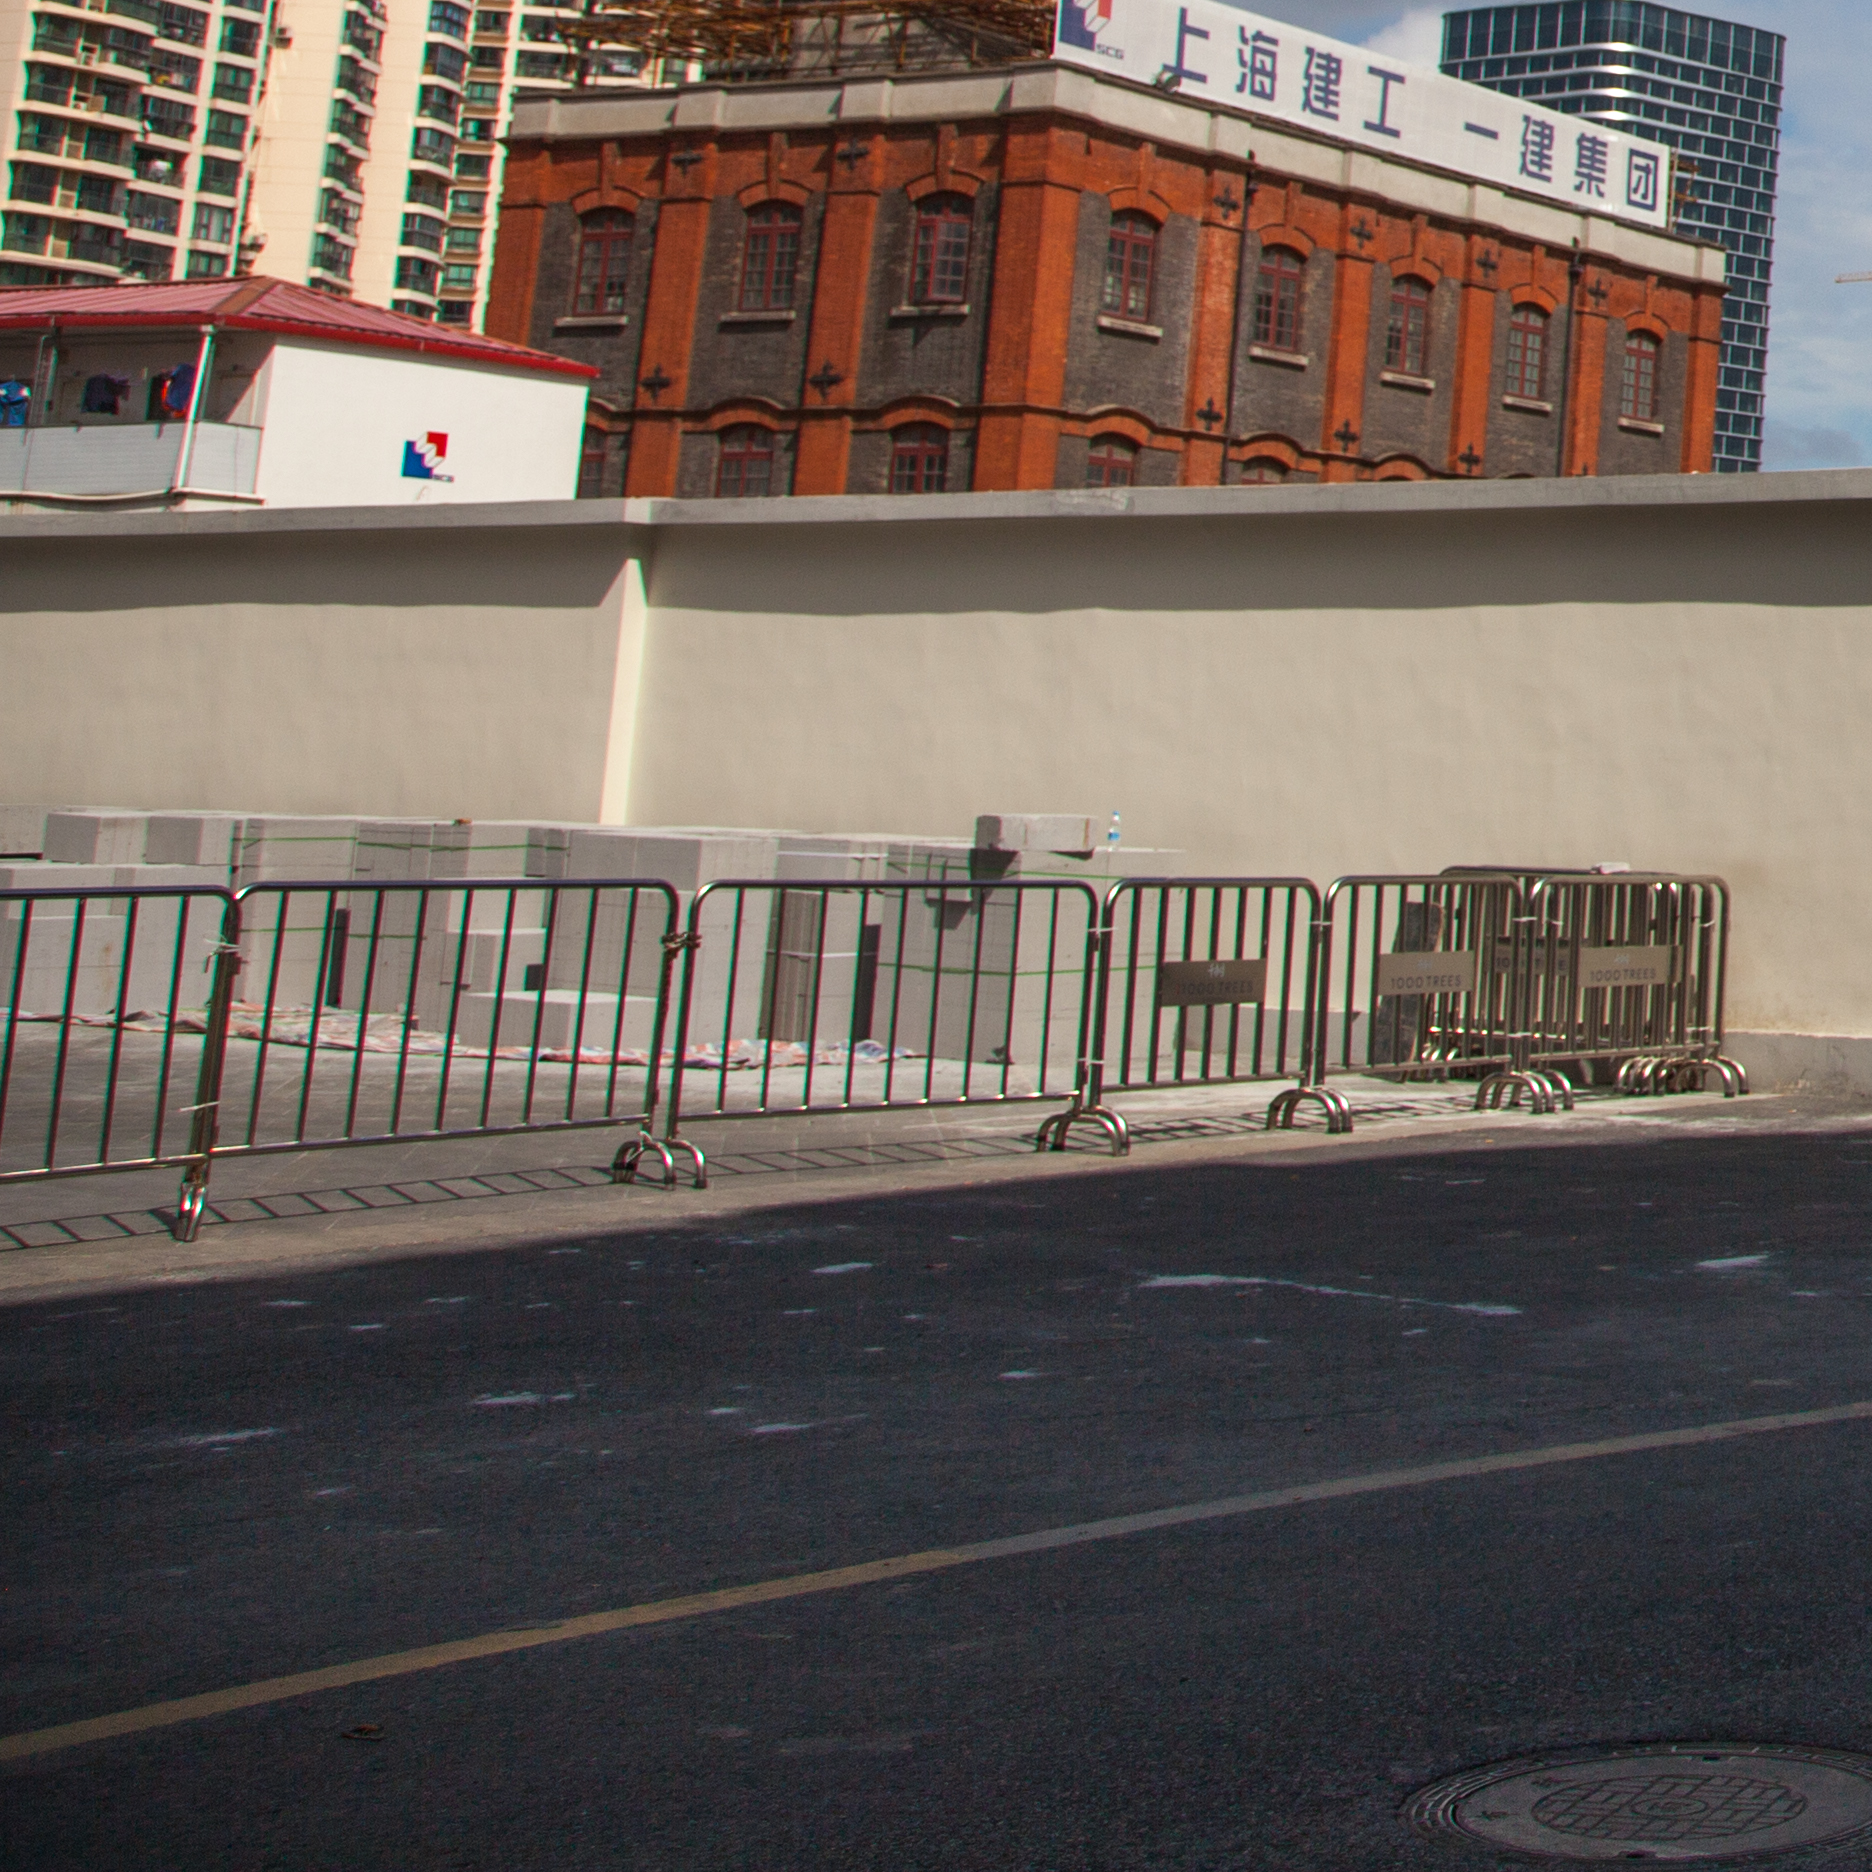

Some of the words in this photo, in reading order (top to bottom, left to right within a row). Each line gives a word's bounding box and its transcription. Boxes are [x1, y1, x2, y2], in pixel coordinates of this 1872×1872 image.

[1096, 43, 1124, 60] SCG
[1161, 6, 1406, 139] 上海建工
[1463, 114, 1659, 211] 一建集团
[1425, 974, 1462, 988] TREES
[1622, 967, 1657, 981] TREES
